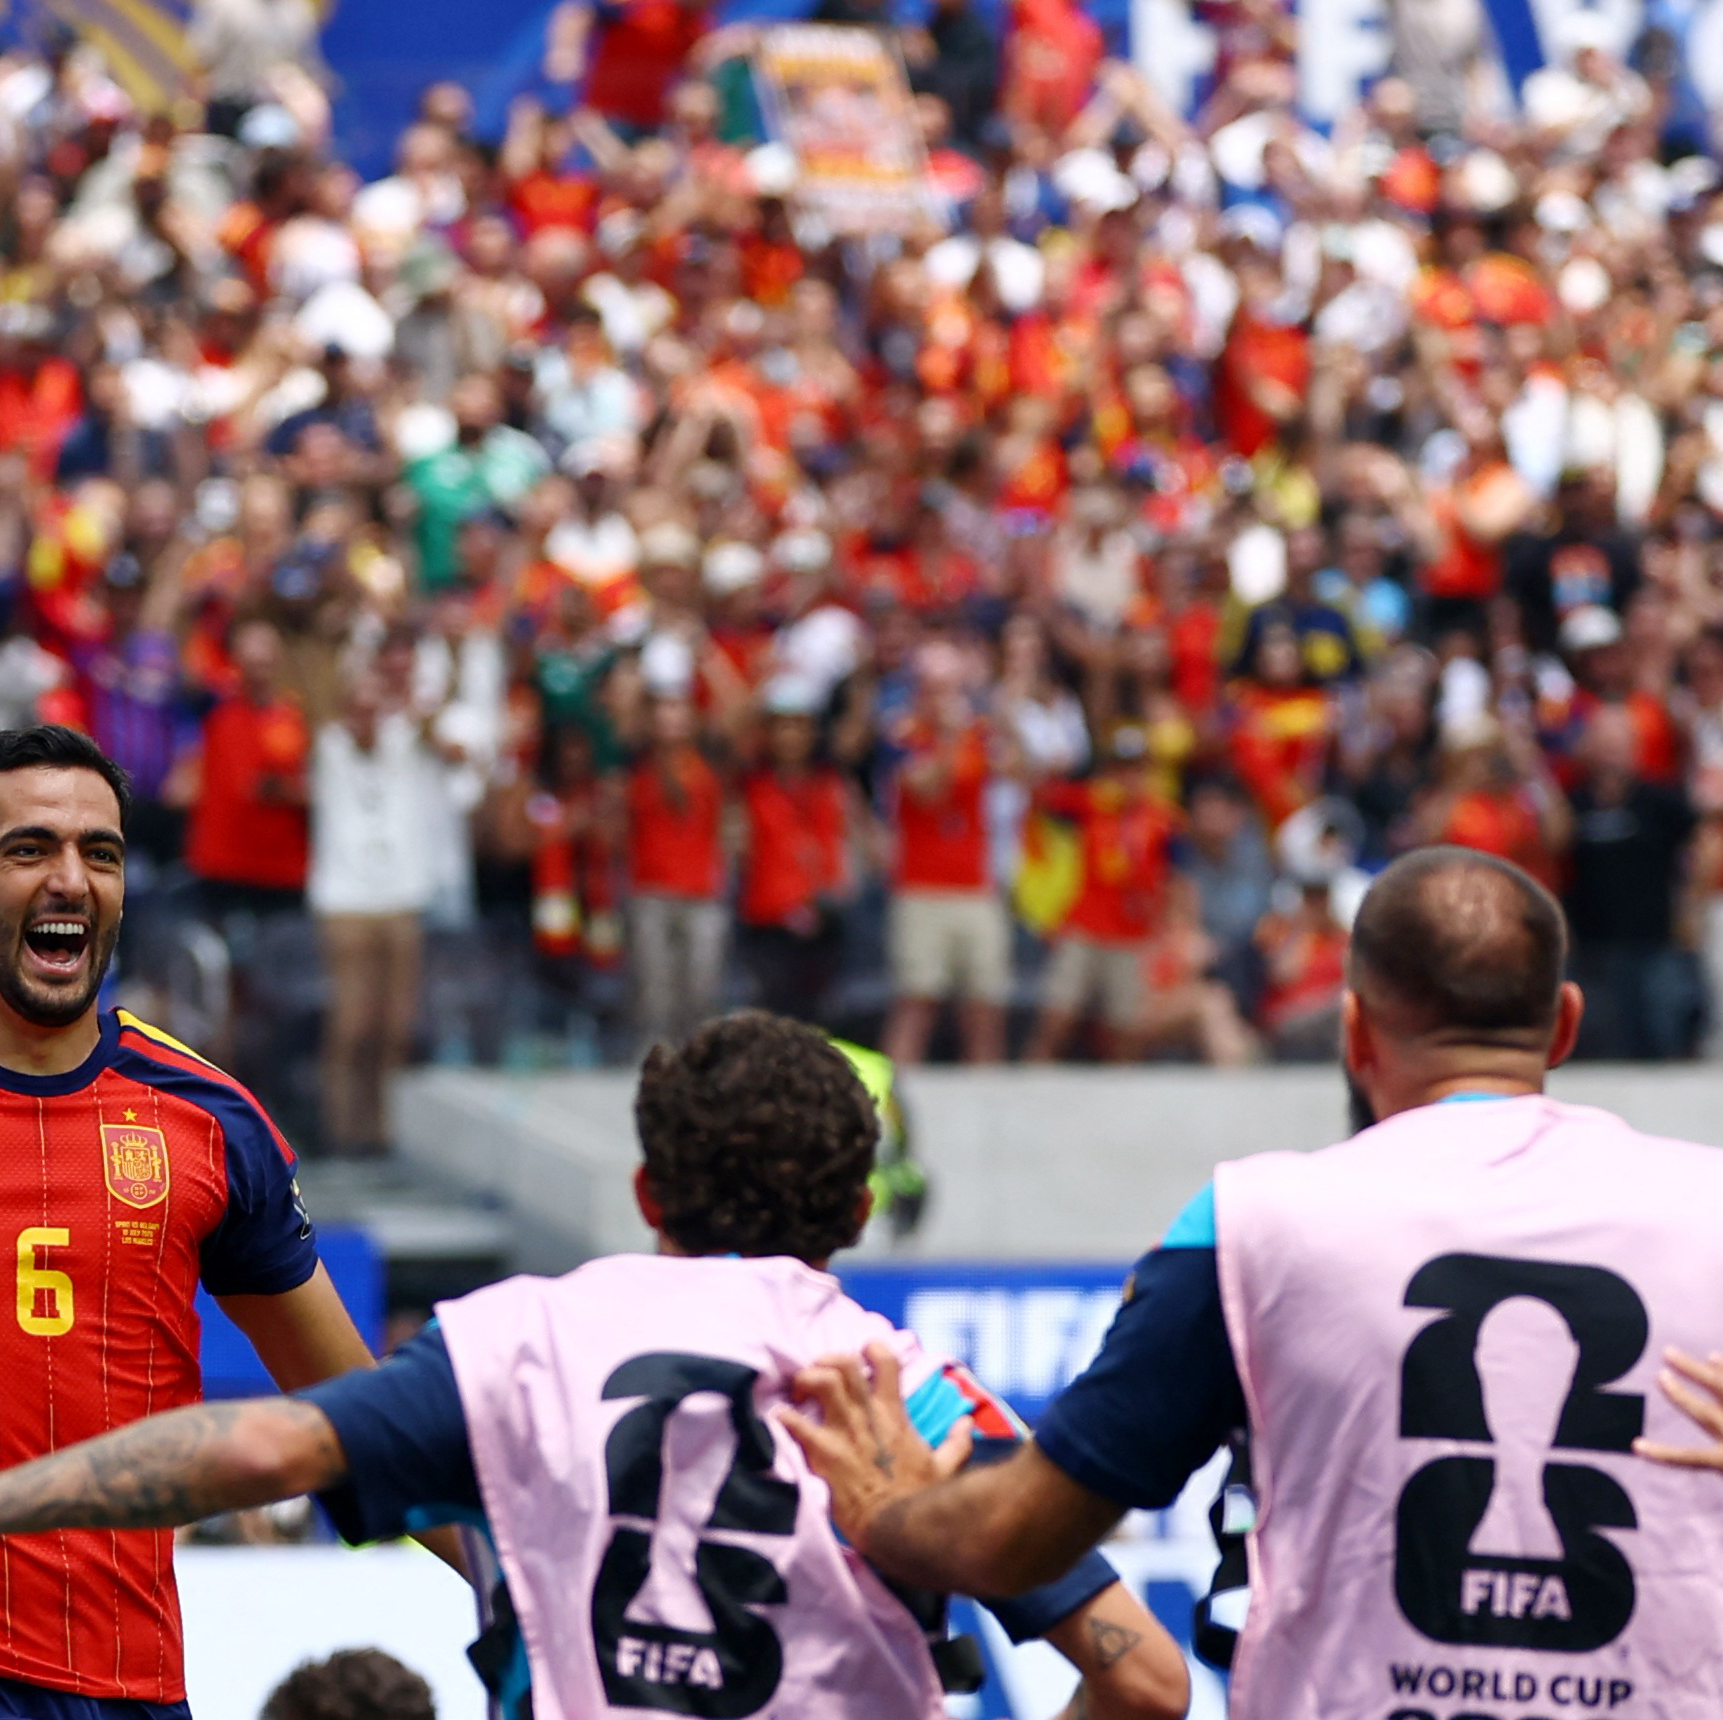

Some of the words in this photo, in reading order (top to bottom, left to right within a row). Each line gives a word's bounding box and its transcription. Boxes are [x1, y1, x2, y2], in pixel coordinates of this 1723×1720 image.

[17, 1226, 75, 1336] 6
[1460, 1568, 1573, 1622] FIFA
[616, 1635, 724, 1690] FIFA
[1389, 1663, 1537, 1702] WORLD
[1549, 1674, 1633, 1709] CUP
